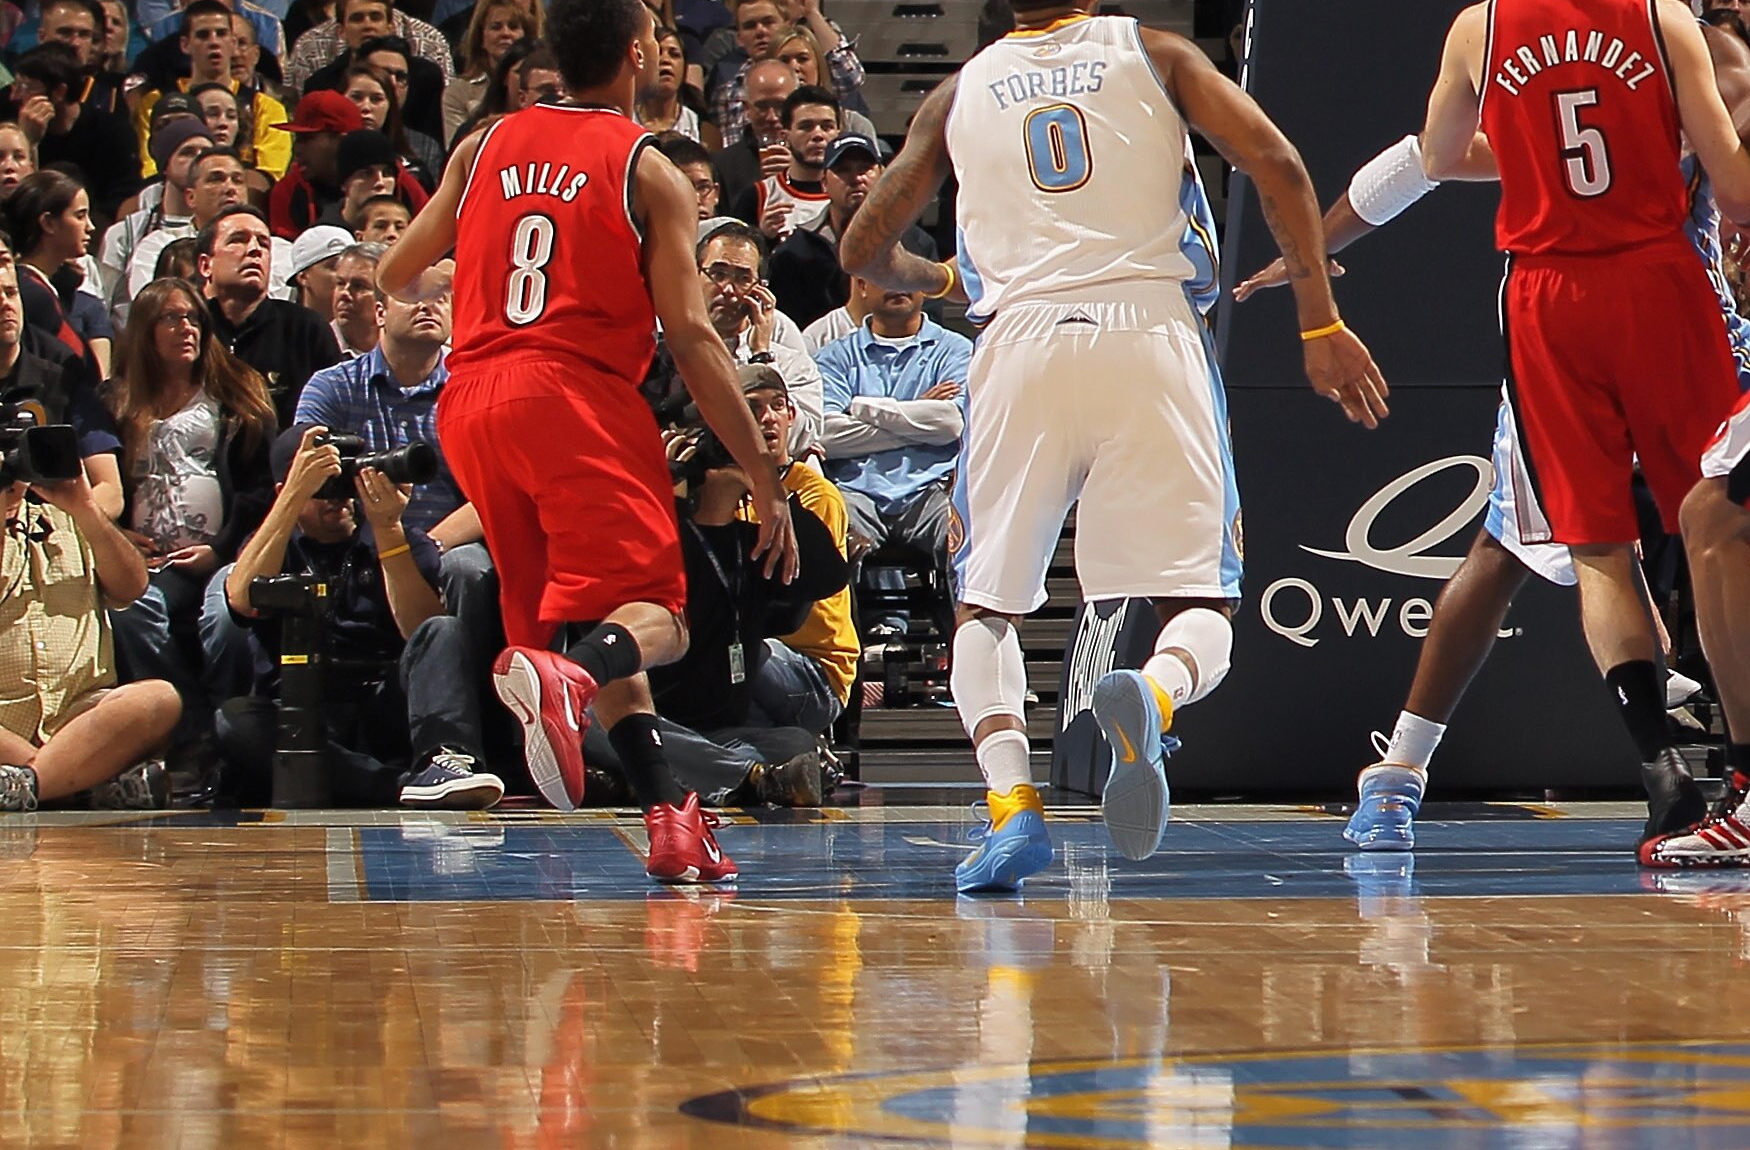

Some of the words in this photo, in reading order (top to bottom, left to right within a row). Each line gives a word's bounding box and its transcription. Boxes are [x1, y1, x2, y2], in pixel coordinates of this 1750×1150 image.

[989, 61, 1107, 111] FORBES
[1495, 29, 1656, 96] FERNANDEZ
[1024, 103, 1094, 193] 0
[1556, 90, 1613, 199] 5
[500, 162, 589, 203] MILLS
[506, 212, 556, 327] 8
[1260, 577, 1514, 648] Qwe
